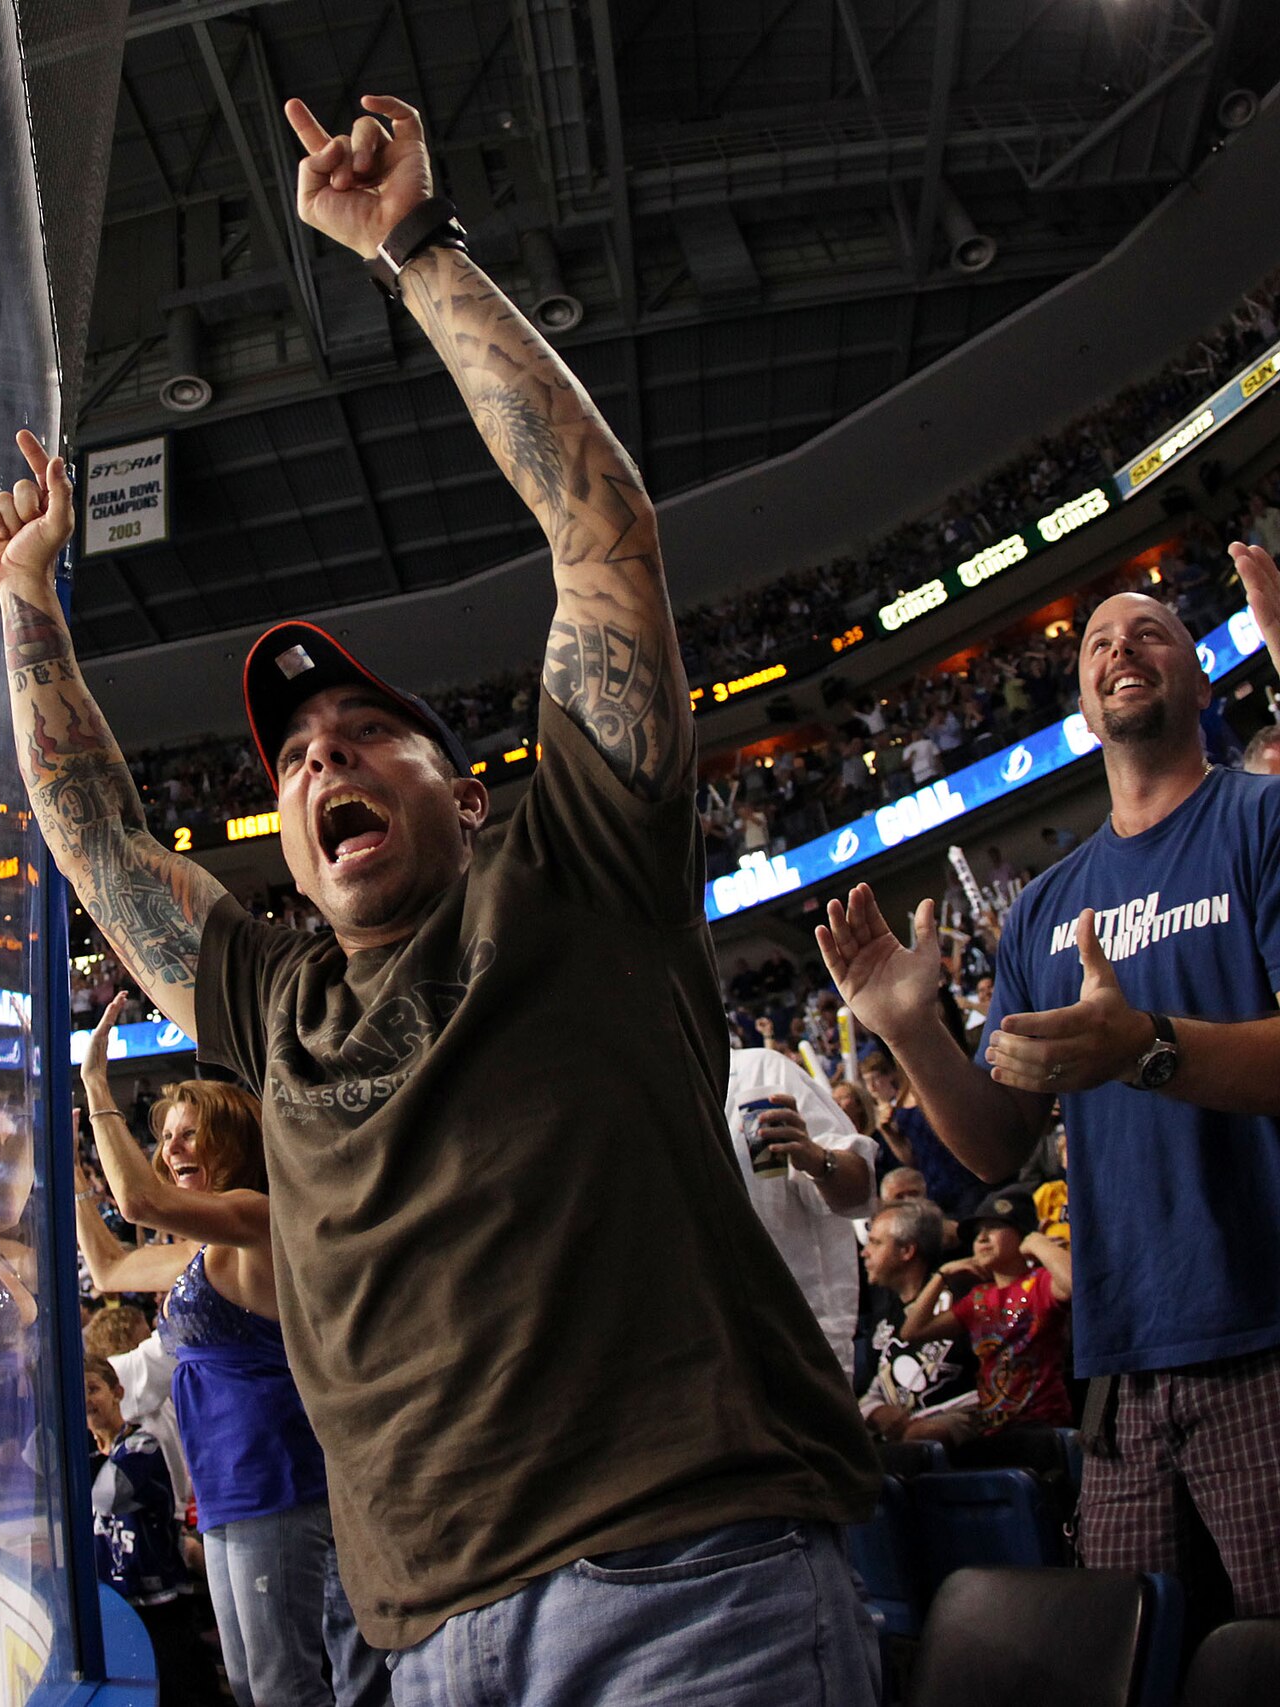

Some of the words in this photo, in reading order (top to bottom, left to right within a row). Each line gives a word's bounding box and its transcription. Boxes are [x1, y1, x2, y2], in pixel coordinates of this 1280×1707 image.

[1243, 362, 1273, 392] SUN
[90, 453, 162, 478] STORM
[89, 489, 125, 506] ARENA
[129, 480, 162, 498] BOWL
[92, 495, 158, 520] CHAMPIONS
[109, 521, 142, 541] 2003
[1037, 497, 1109, 542] Times
[958, 543, 1028, 587] Times
[879, 588, 948, 630] Times
[712, 682, 729, 702] 3
[875, 779, 966, 846] GOAL
[174, 827, 192, 852] 2
[713, 854, 801, 914] GOAL
[1079, 893, 1230, 965] OMPETITION
[339, 1081, 370, 1110] &
